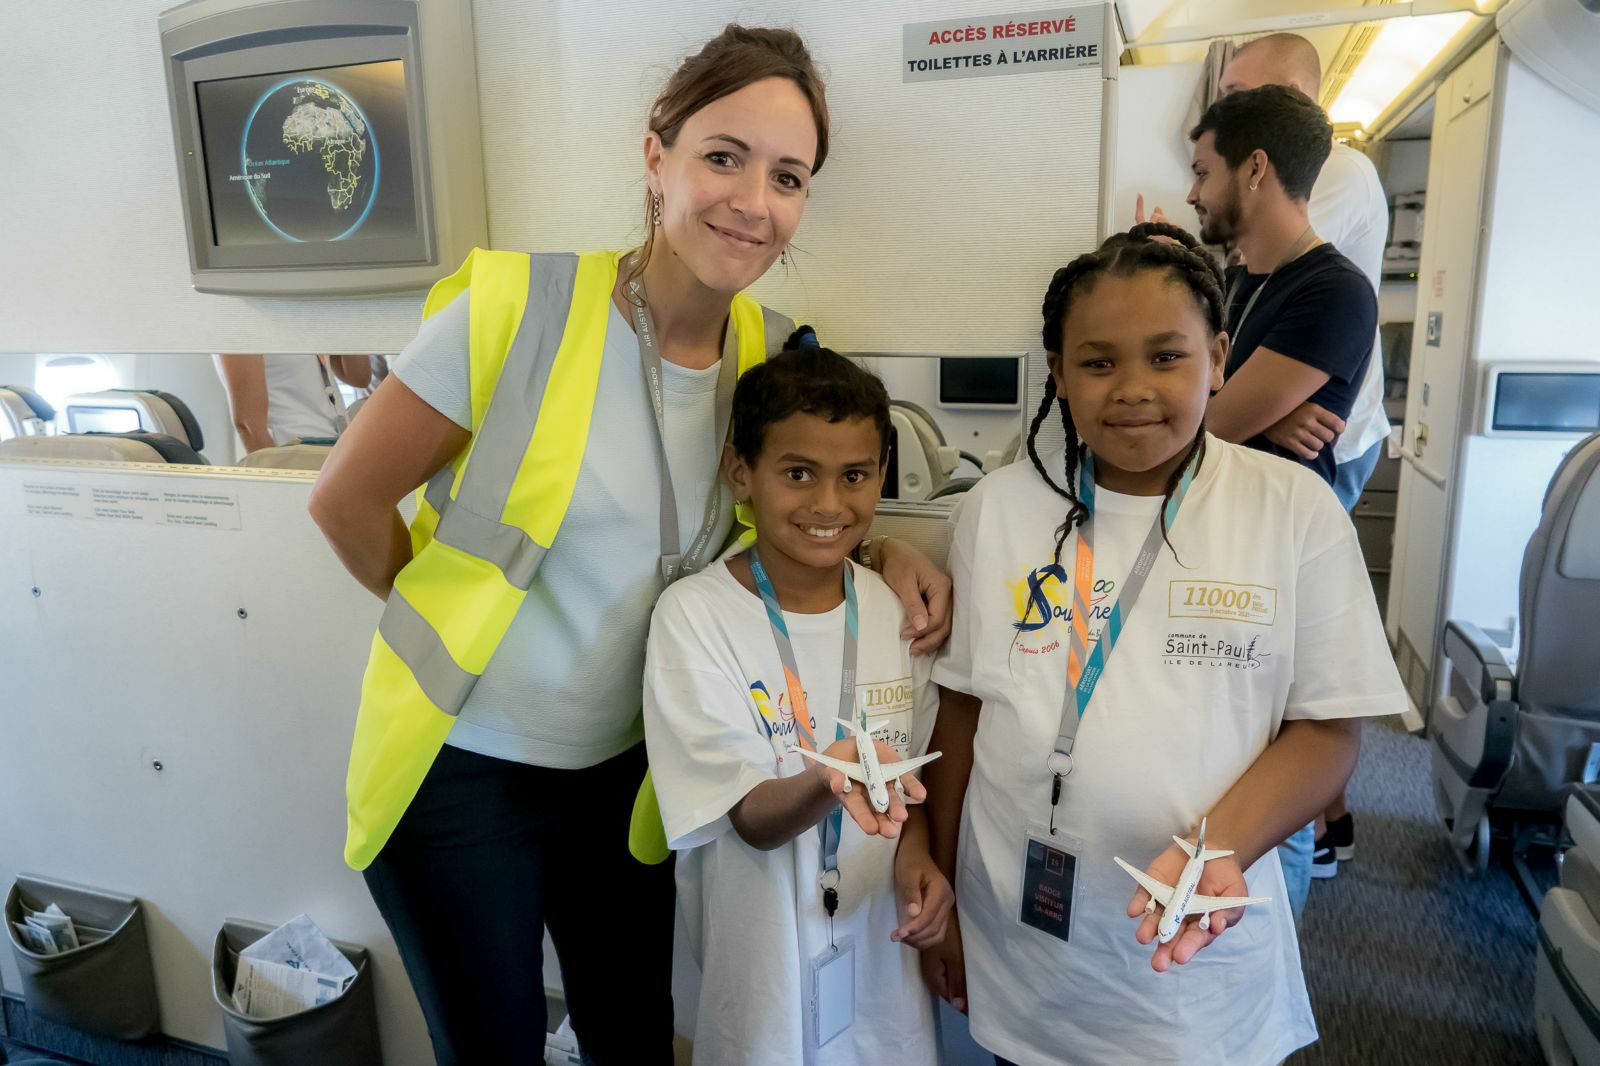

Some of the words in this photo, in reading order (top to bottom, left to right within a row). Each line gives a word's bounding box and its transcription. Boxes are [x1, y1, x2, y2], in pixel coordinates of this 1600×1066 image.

[928, 25, 987, 45] ACCÈS
[993, 15, 1076, 39] RÉSERVÉ
[908, 53, 992, 72] TOILETTES
[997, 50, 1008, 65] À
[1013, 44, 1098, 64] L'ARRIÈRE
[1184, 587, 1251, 609] 11000
[1165, 639, 1246, 659] Saint-Paul
[1039, 883, 1061, 898] BADGE
[1034, 892, 1064, 911] VISITEUR
